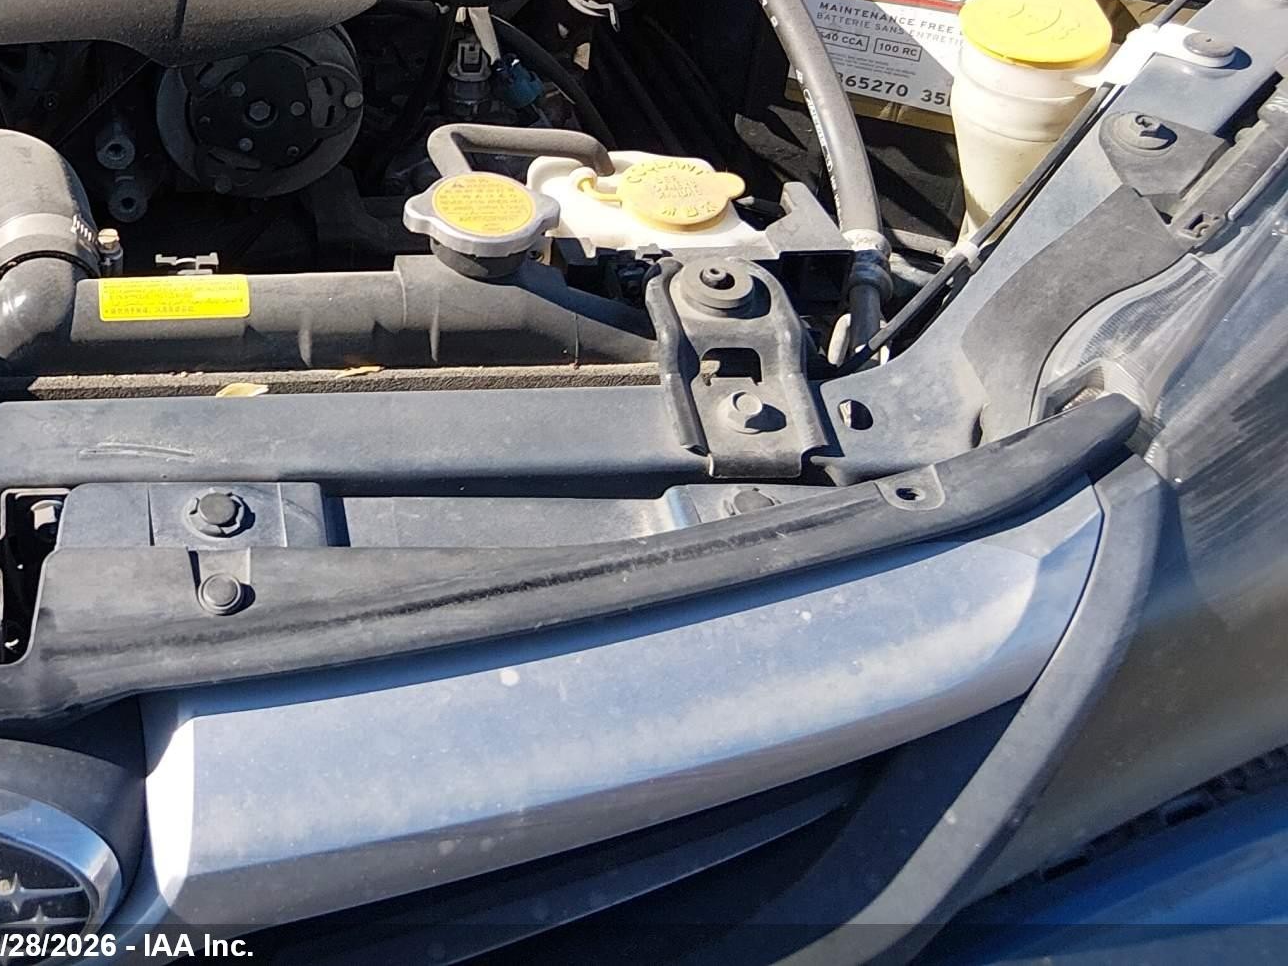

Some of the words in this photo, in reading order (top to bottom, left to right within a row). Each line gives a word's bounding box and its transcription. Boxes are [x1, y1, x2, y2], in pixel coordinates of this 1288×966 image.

[816, 12, 872, 29] BATTERIE
[874, 22, 905, 35] SANS
[819, 1, 915, 26] MAINTENANCE
[919, 20, 955, 34] FREE
[841, 36, 863, 47] CCA
[879, 42, 899, 53] 100
[902, 46, 918, 57] RC
[920, 89, 951, 107] 35
